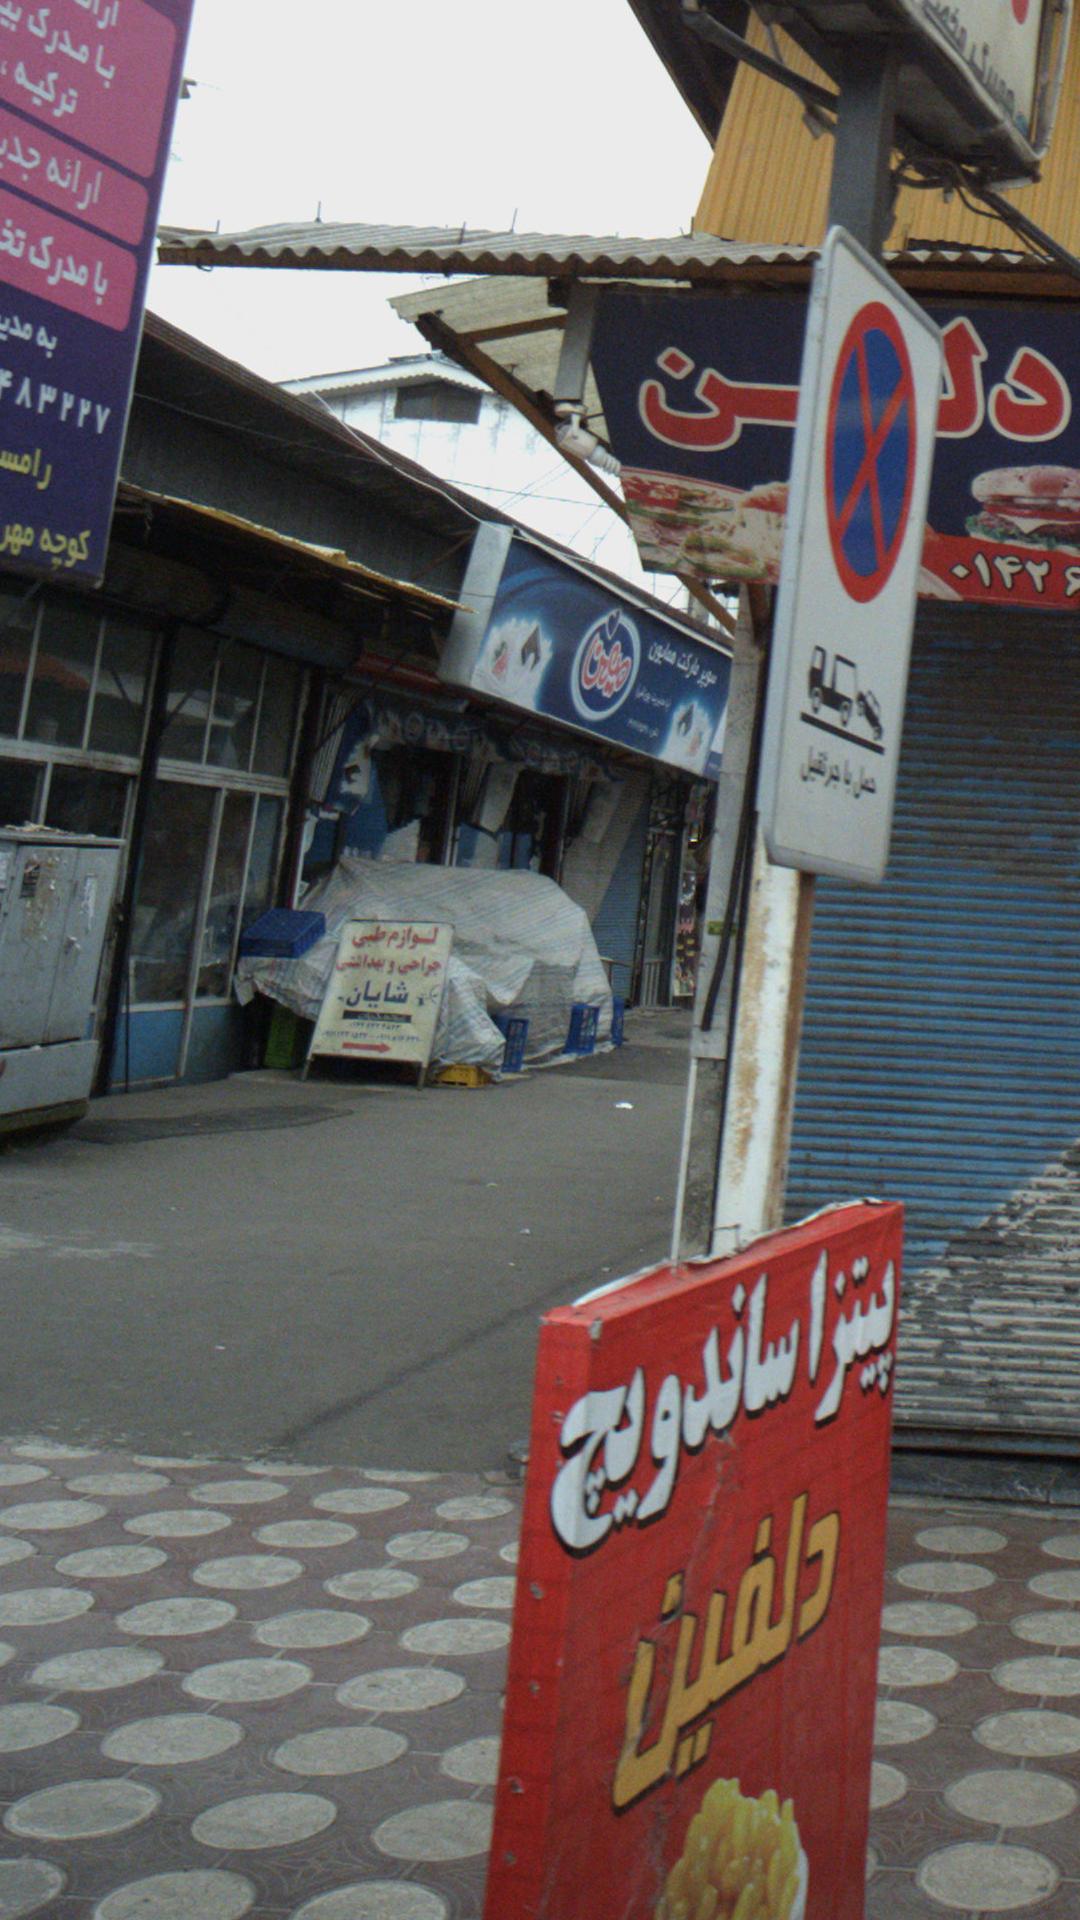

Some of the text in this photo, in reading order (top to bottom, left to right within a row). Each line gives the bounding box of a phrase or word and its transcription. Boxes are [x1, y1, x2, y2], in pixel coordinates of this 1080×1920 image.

[28, 8, 90, 64] مدرک
[96, 45, 116, 89] با
[28, 235, 90, 286] مدرک
[93, 260, 109, 305] با
[36, 326, 58, 358] به
[39, 528, 92, 570] کوچه
[799, 745, 877, 800] حمل با جرثقیل
[351, 925, 440, 951] لوازم طبی
[387, 960, 396, 976] و
[398, 954, 442, 977] جراحی
[345, 979, 410, 1009] شایان
[549, 1248, 897, 1558] پیتزا ساندویچ
[611, 1492, 841, 1817] دلفین
